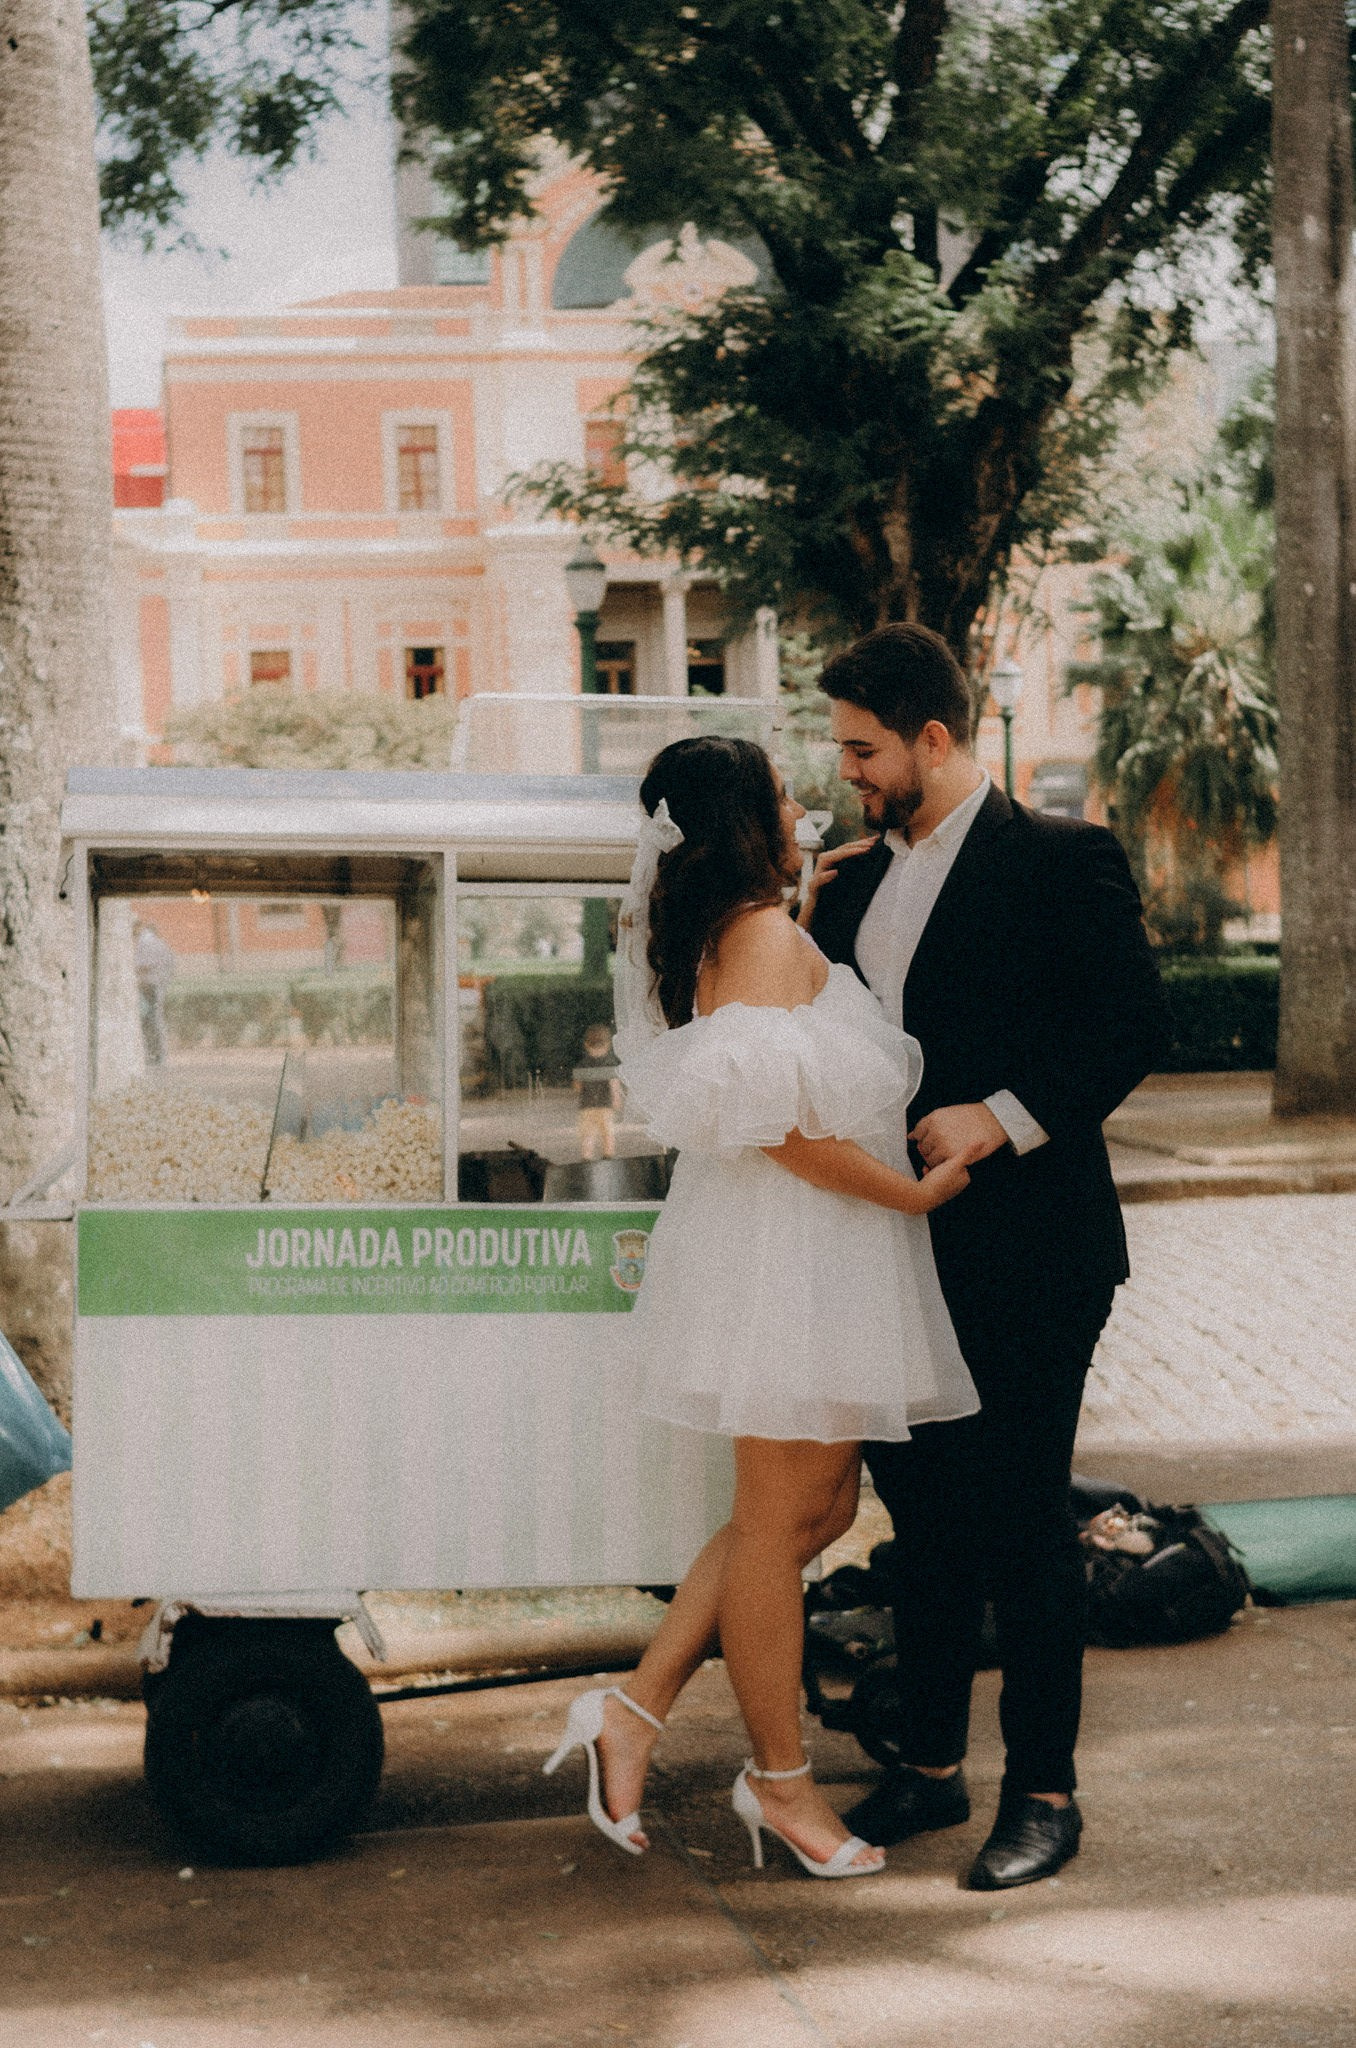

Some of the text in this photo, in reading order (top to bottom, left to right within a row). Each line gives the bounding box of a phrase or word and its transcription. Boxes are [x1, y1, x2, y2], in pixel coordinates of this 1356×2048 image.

[246, 1227, 592, 1268] JORNADA PRODUTIVA
[330, 1275, 348, 1296] DE
[524, 1275, 589, 1294] POPULAR
